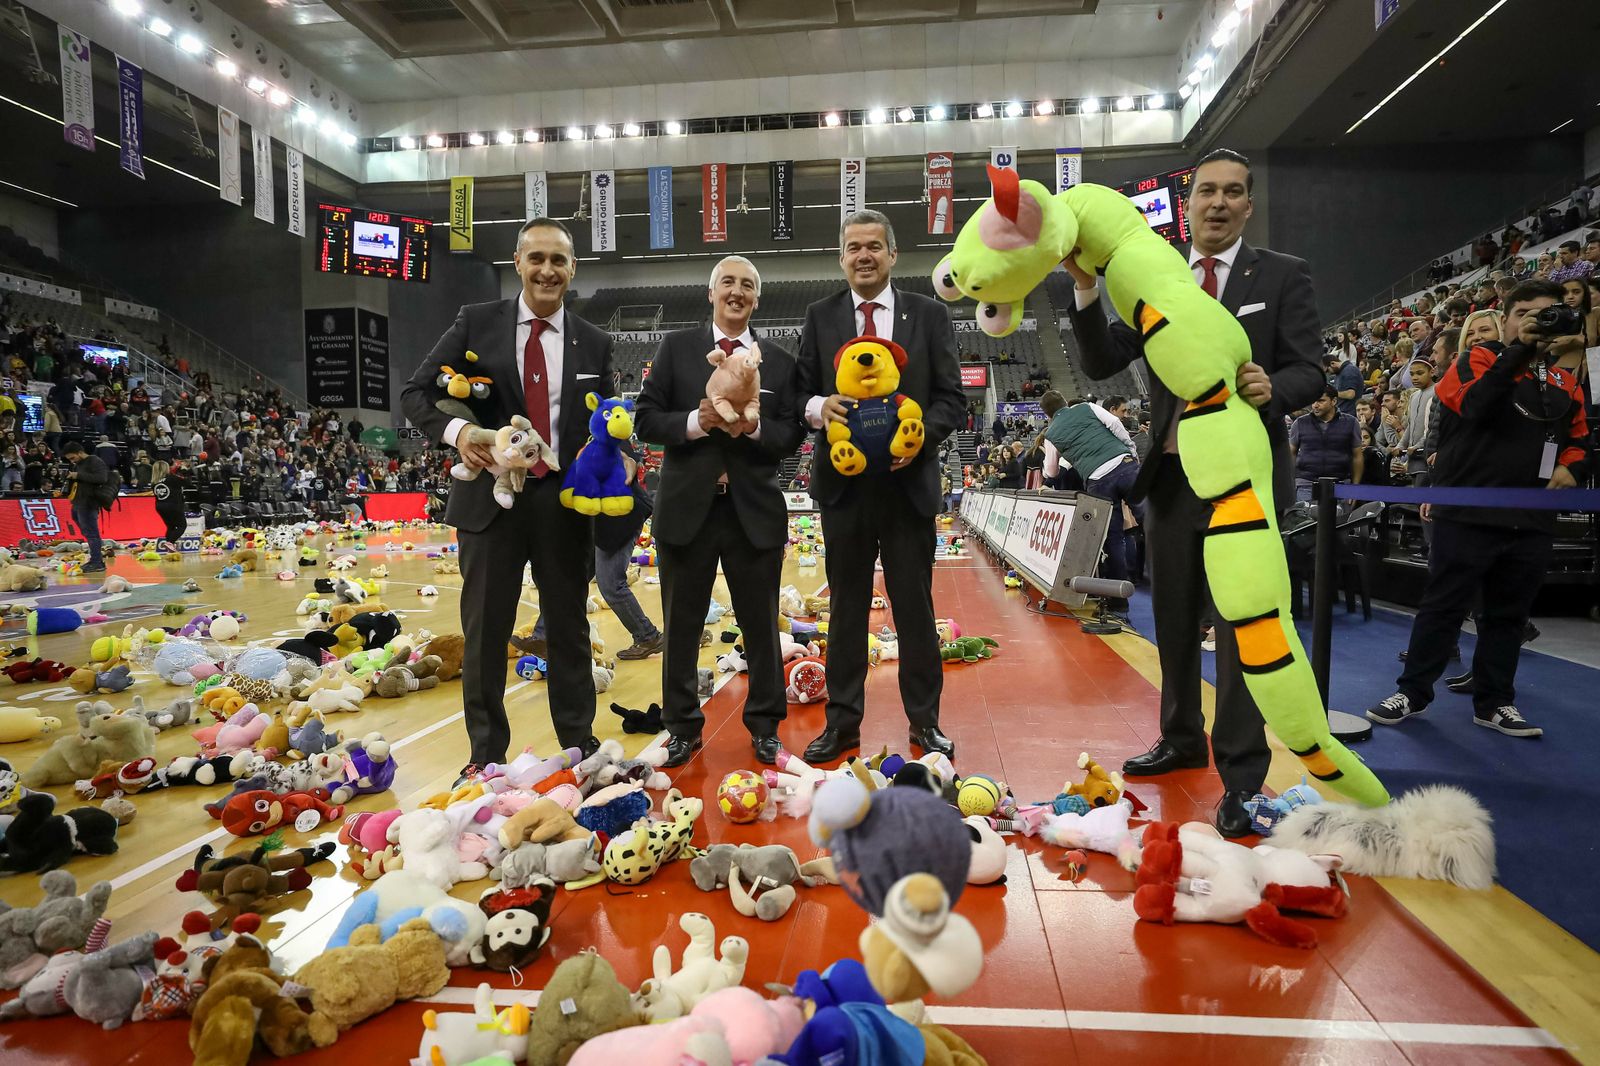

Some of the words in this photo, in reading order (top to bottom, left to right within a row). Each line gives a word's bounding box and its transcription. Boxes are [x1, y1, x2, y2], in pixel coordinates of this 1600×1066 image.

[63, 65, 72, 113] Deportes
[74, 70, 83, 107] Palacio
[660, 169, 668, 180] LA
[929, 178, 952, 186] PUREZA
[1138, 178, 1158, 191] 1203
[660, 181, 669, 222] ESQUINITA
[333, 212, 345, 221] 27
[368, 212, 390, 223] 1203
[414, 224, 425, 233] 35
[451, 184, 471, 243] ANFRASA
[767, 328, 803, 337] IDEA
